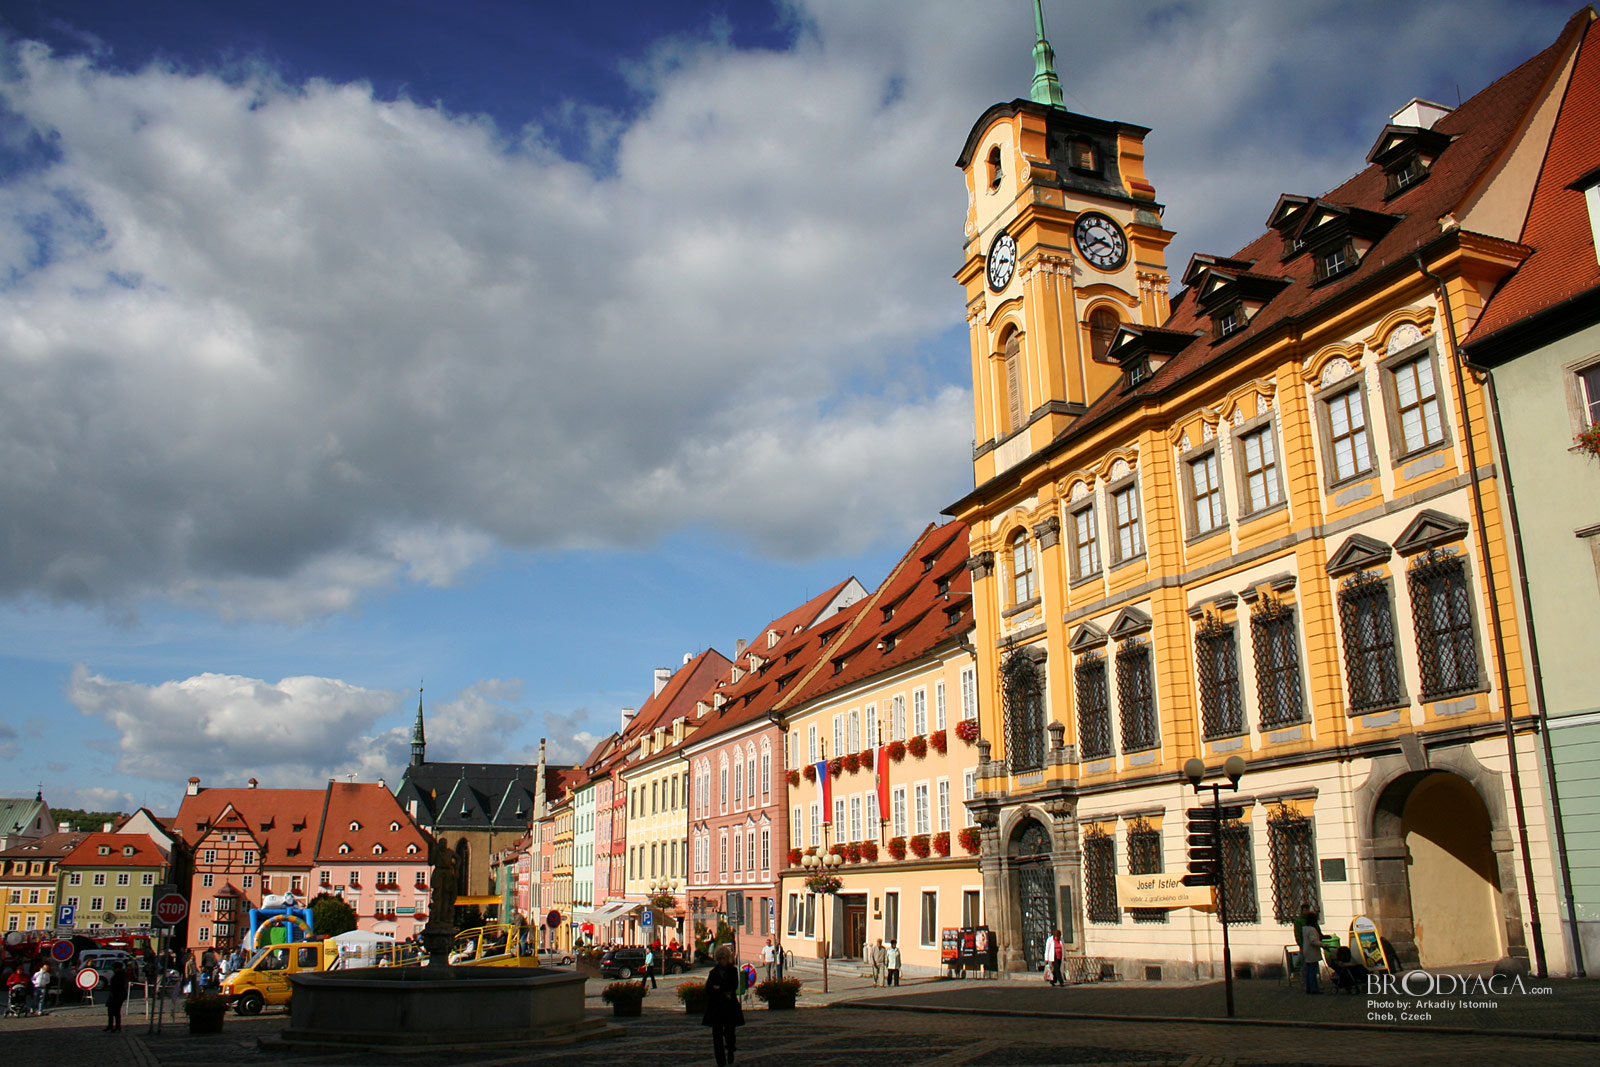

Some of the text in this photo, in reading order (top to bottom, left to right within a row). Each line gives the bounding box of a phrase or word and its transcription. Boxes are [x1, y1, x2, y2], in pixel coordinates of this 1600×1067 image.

[1137, 879, 1155, 890] Josef
[1158, 878, 1179, 889] Istler
[61, 907, 72, 920] P
[159, 903, 185, 914] STOP
[643, 913, 650, 922] P
